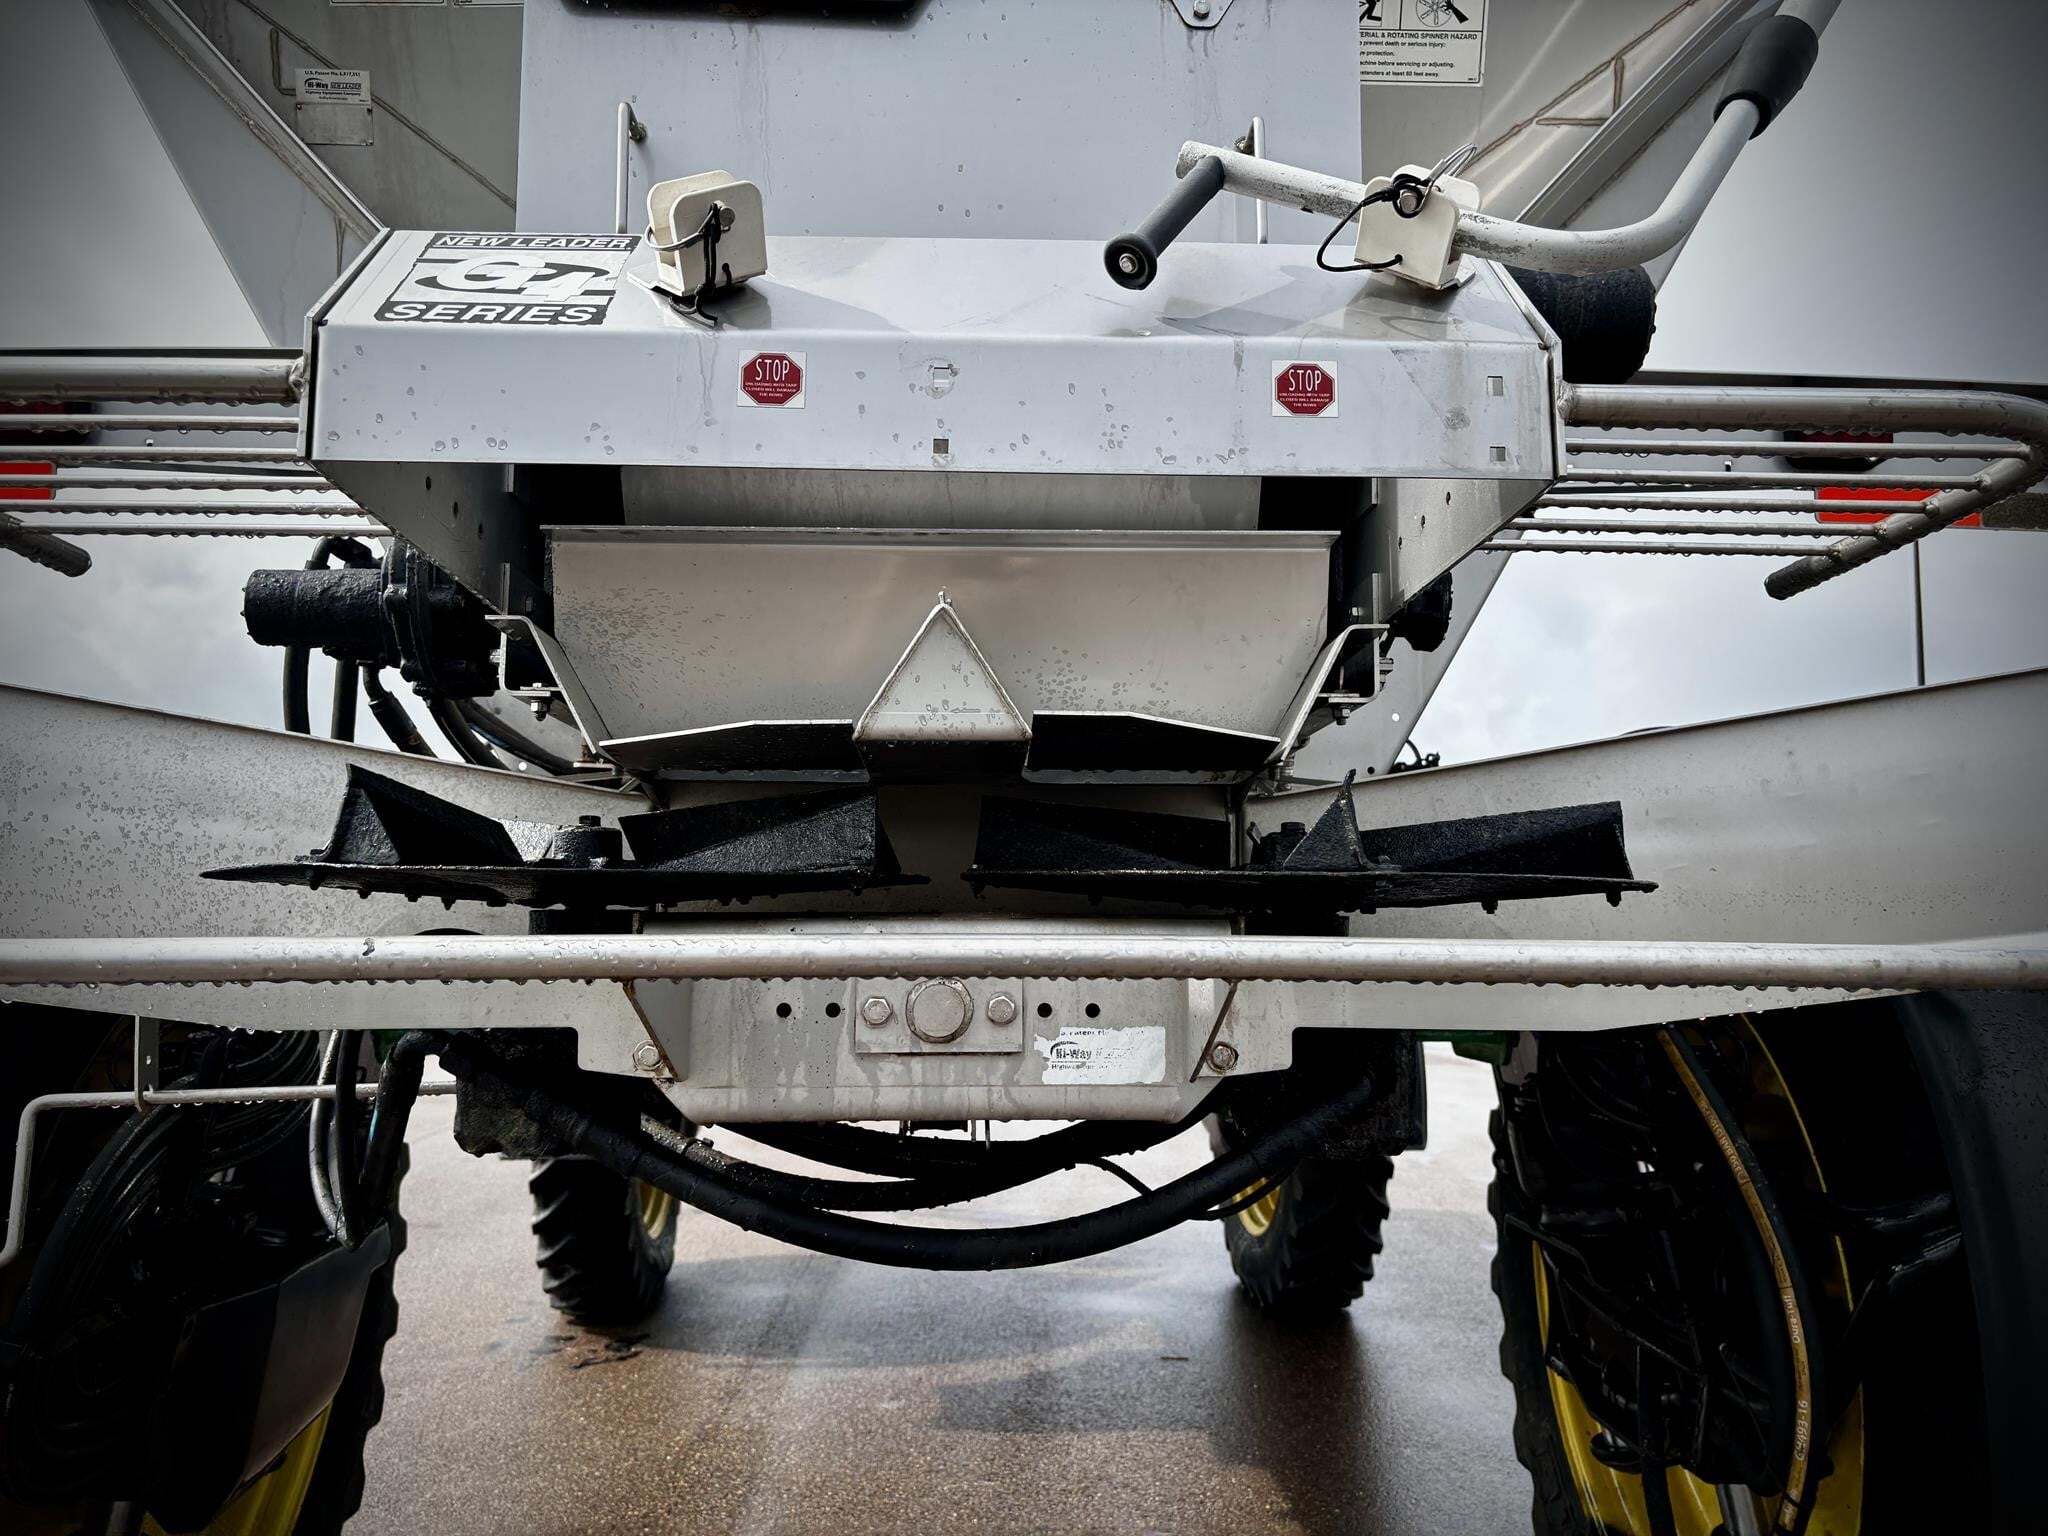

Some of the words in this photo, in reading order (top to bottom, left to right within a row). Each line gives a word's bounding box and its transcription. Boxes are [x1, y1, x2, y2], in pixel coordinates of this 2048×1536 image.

[434, 236, 502, 247] NEW
[512, 238, 631, 249] LEADER
[384, 303, 597, 322] SERIES
[756, 359, 790, 381] STOP
[1289, 369, 1322, 391] STOP
[1056, 1048, 1091, 1060] Hi-Way
